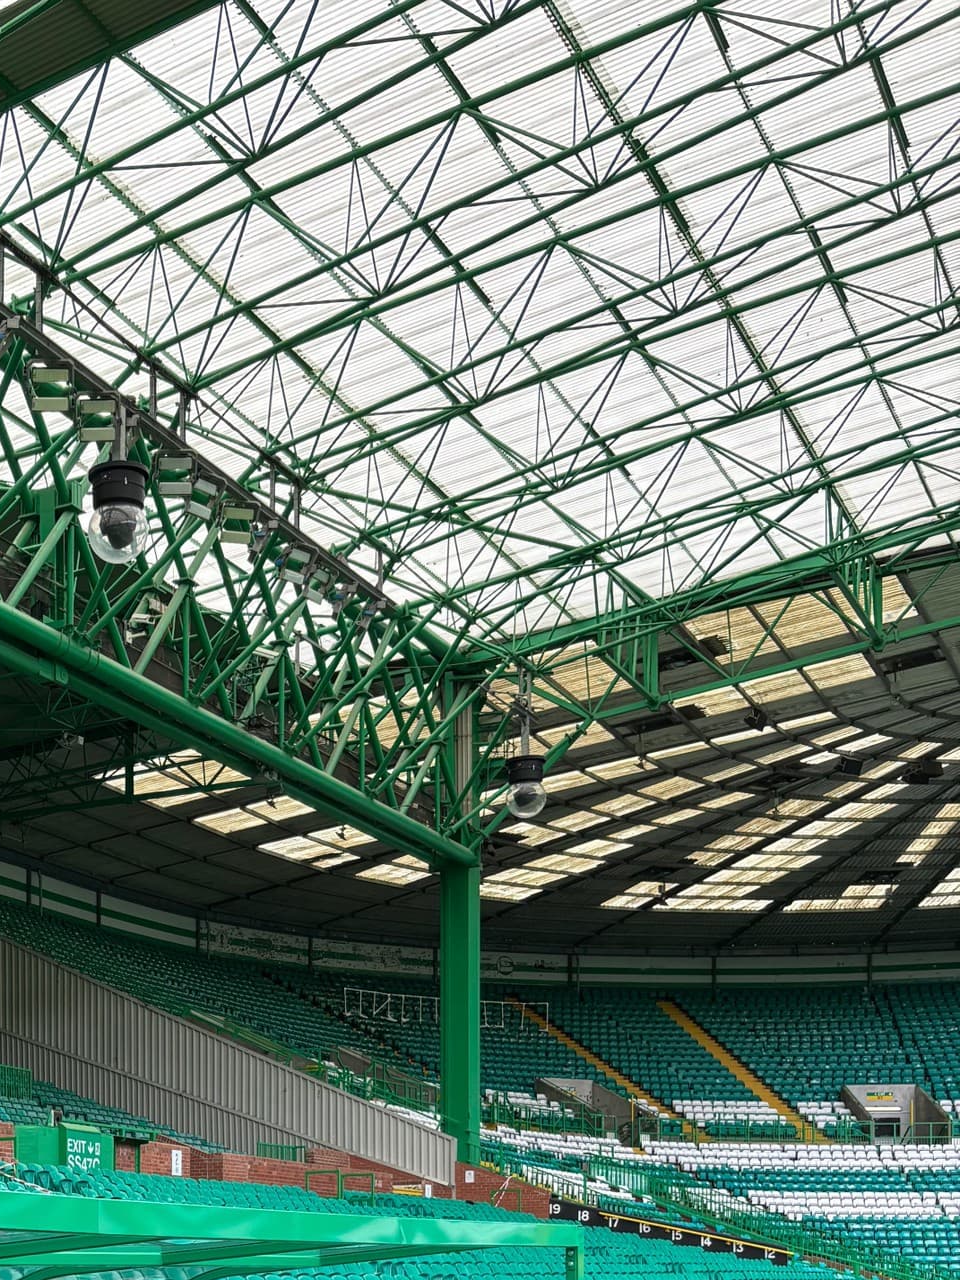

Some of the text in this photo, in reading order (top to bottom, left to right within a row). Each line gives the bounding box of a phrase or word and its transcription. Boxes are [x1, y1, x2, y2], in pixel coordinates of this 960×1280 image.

[66, 1137, 87, 1155] EXIT
[548, 1203, 777, 1260] 19 18 17 16 15 14 13 12
